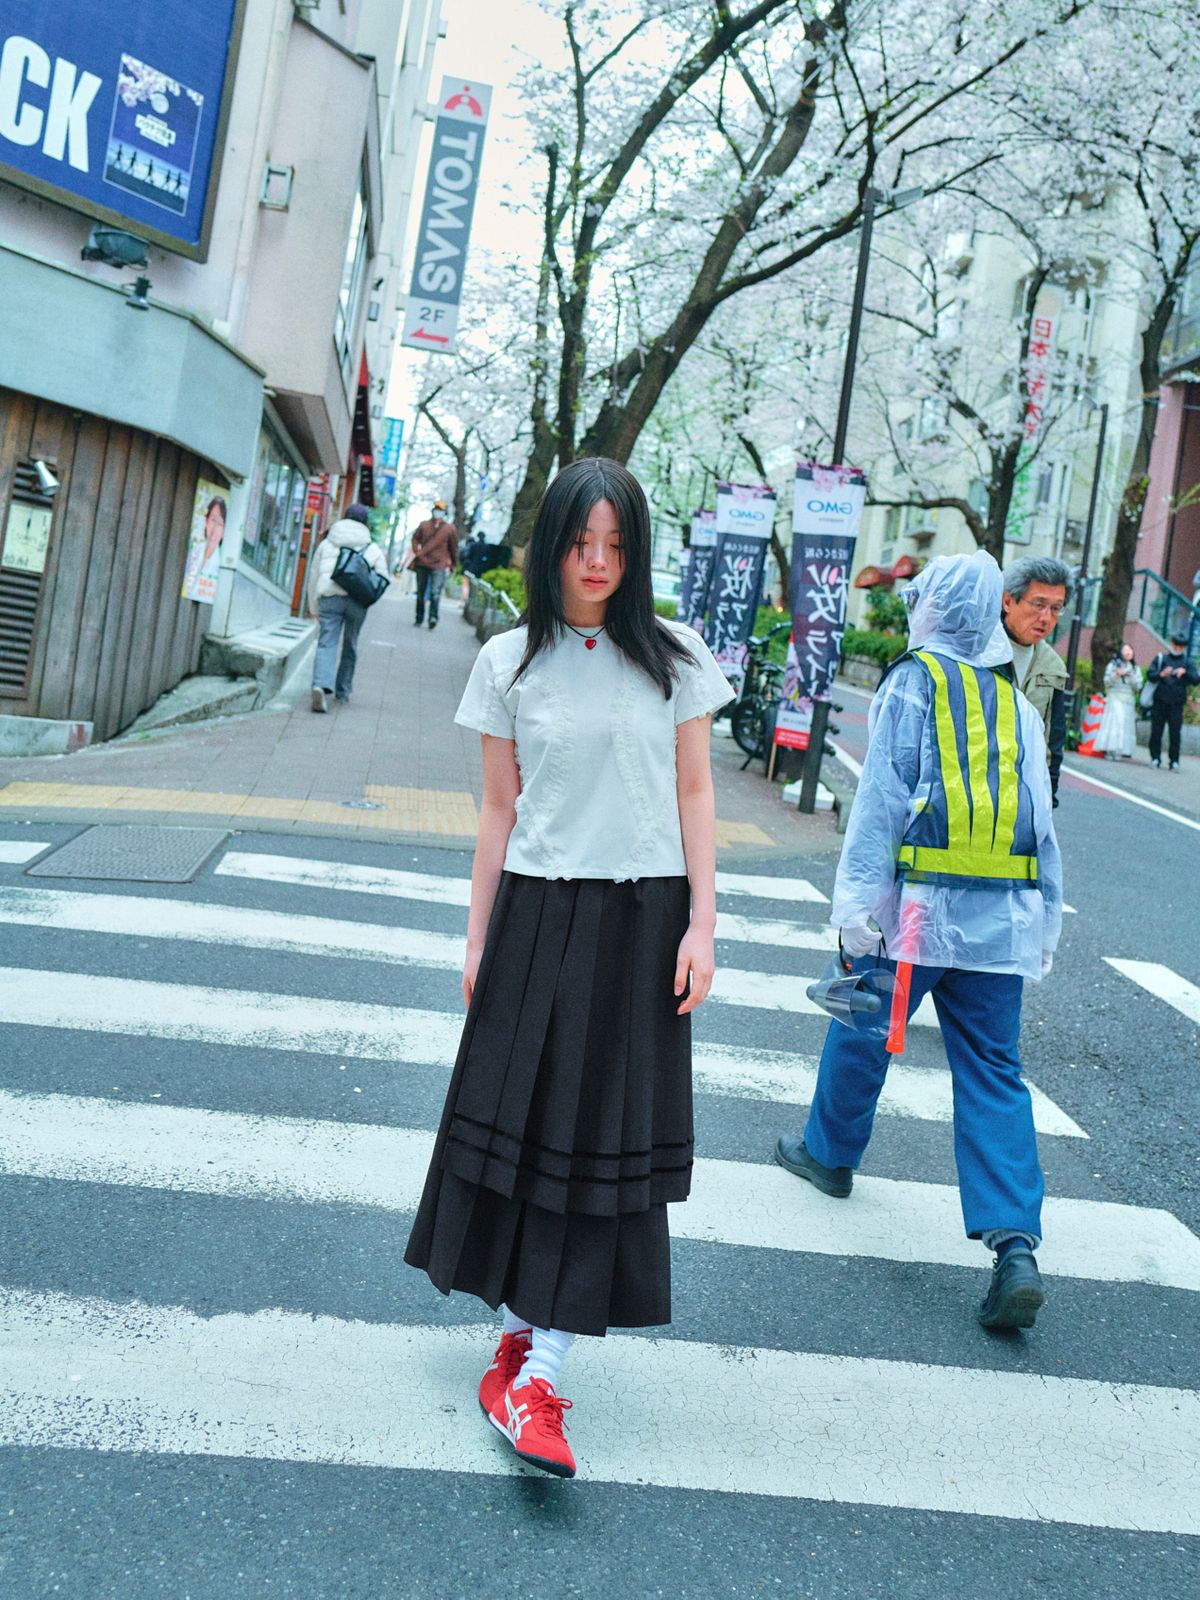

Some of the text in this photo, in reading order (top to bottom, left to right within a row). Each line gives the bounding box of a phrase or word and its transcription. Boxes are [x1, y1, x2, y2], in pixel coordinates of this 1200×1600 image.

[0, 36, 102, 173] CK
[418, 131, 478, 294] TOMAS
[420, 306, 446, 323] 2F
